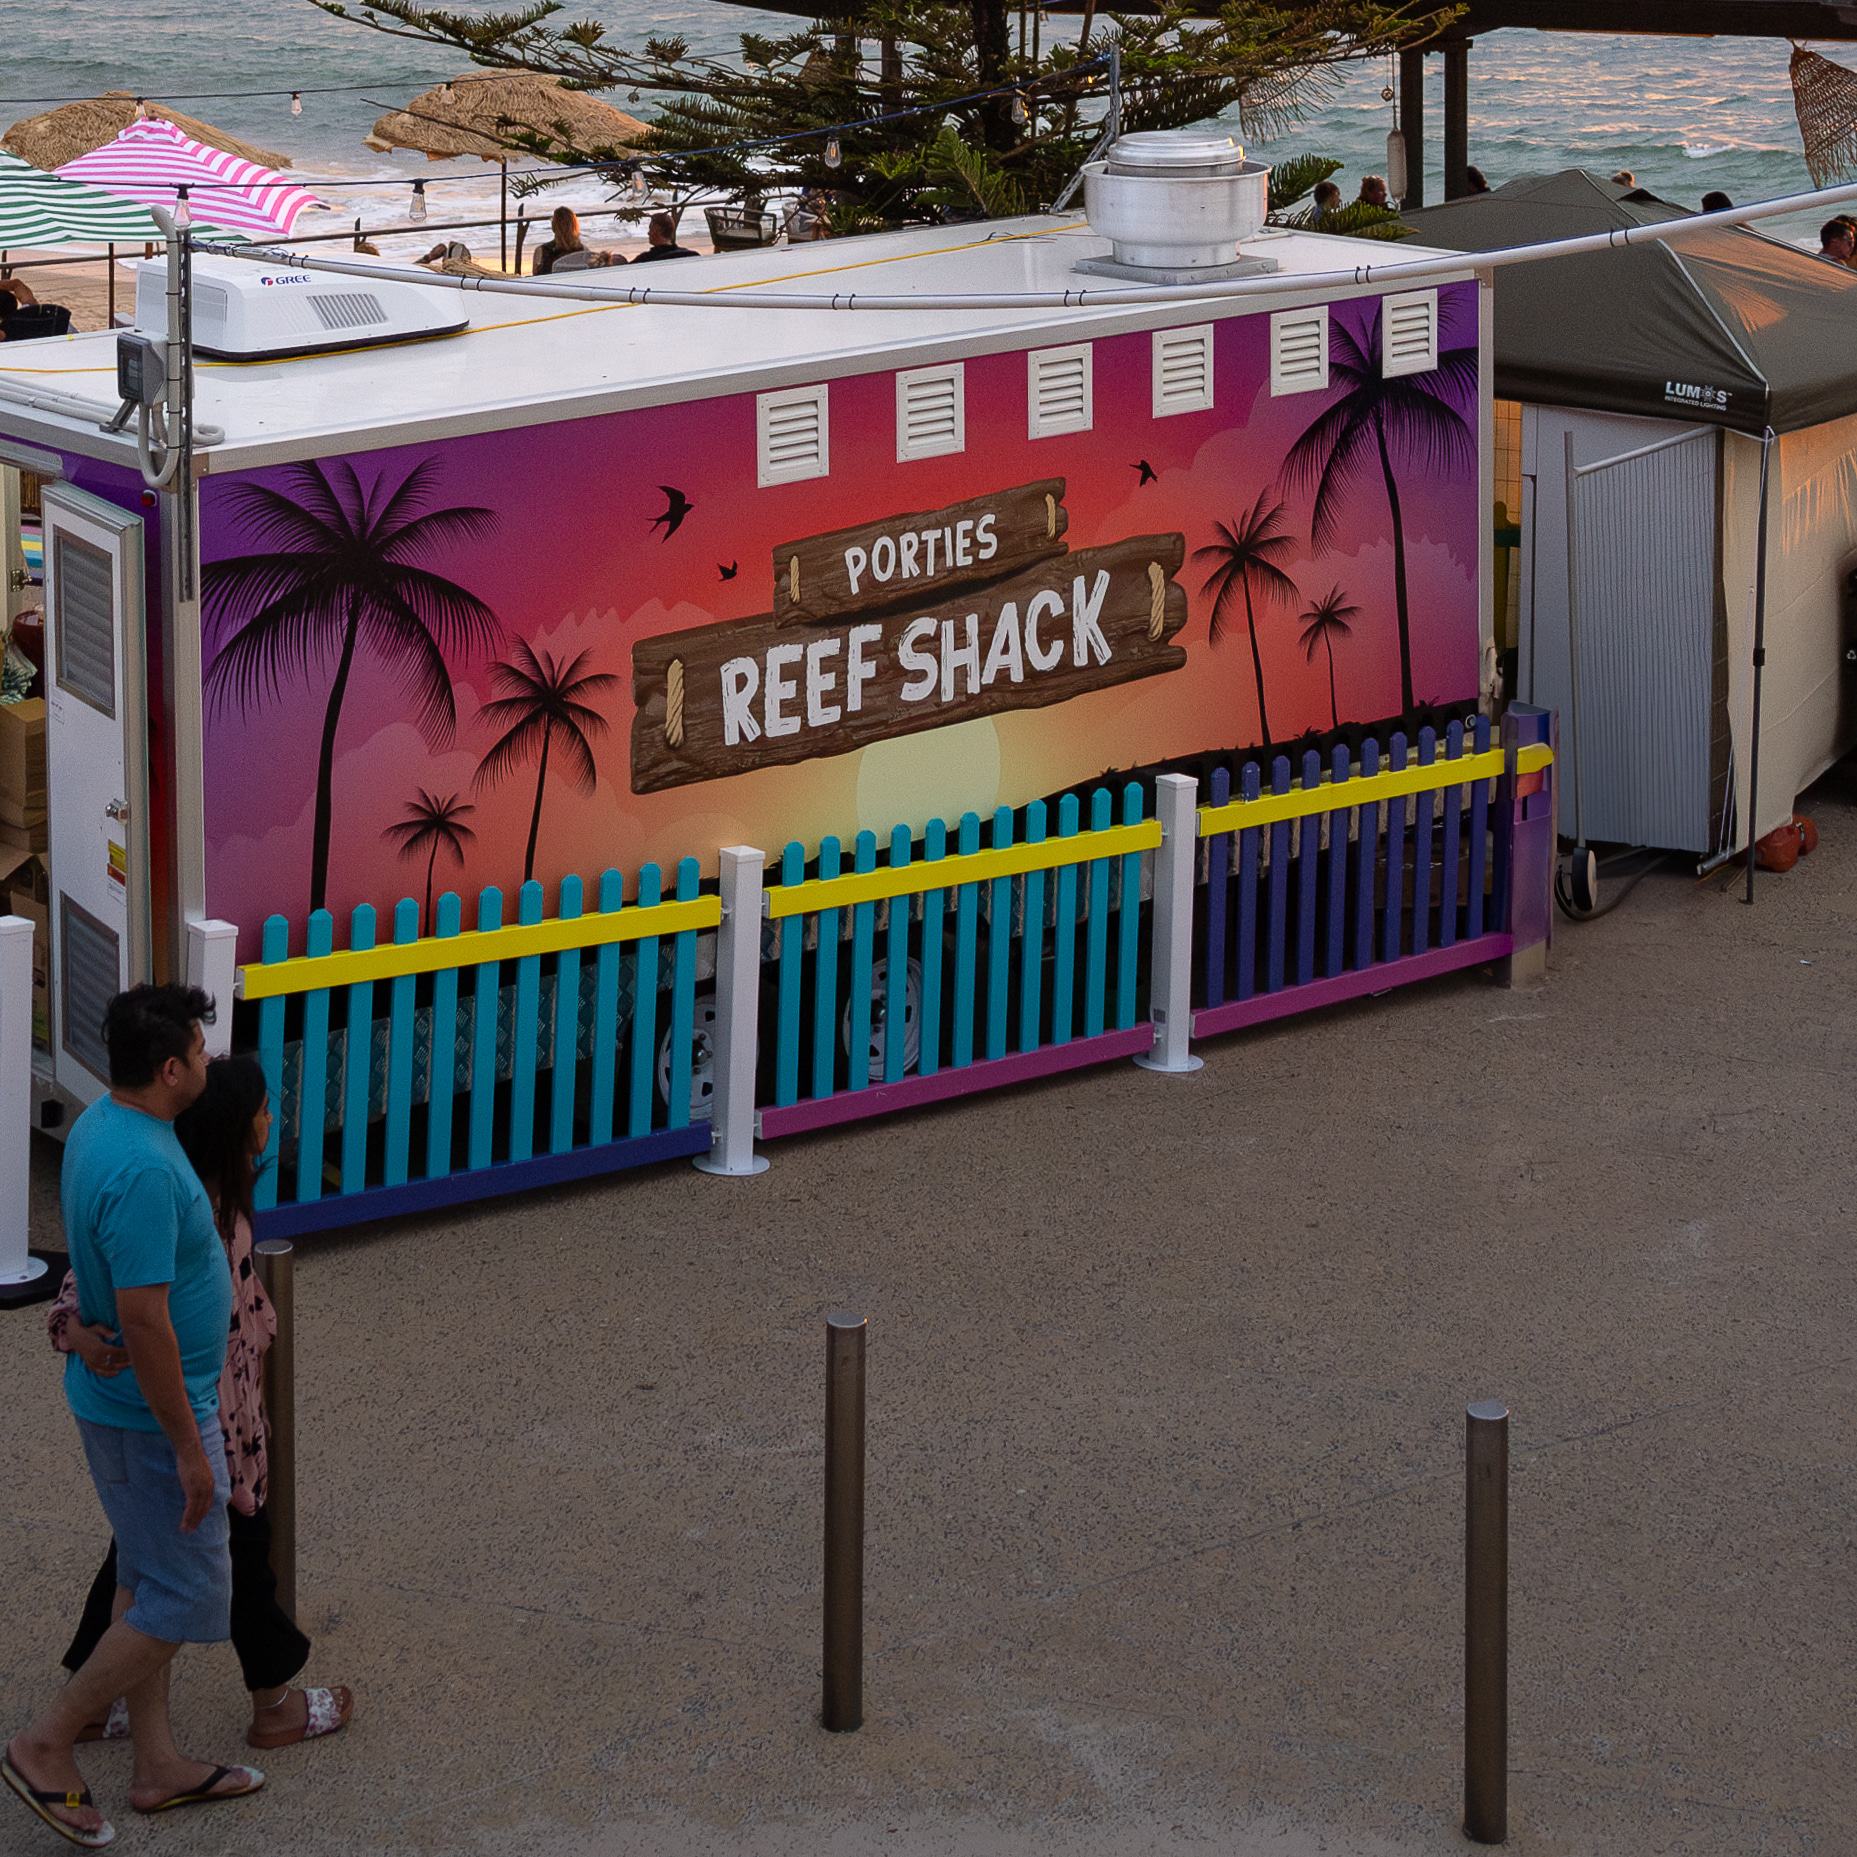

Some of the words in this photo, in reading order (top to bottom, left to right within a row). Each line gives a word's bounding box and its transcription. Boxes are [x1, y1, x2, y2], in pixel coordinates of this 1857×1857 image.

[275, 274, 312, 285] GREE
[844, 513, 999, 596] PORTIES
[719, 624, 883, 746] REEF
[898, 569, 1113, 702] SHACK
